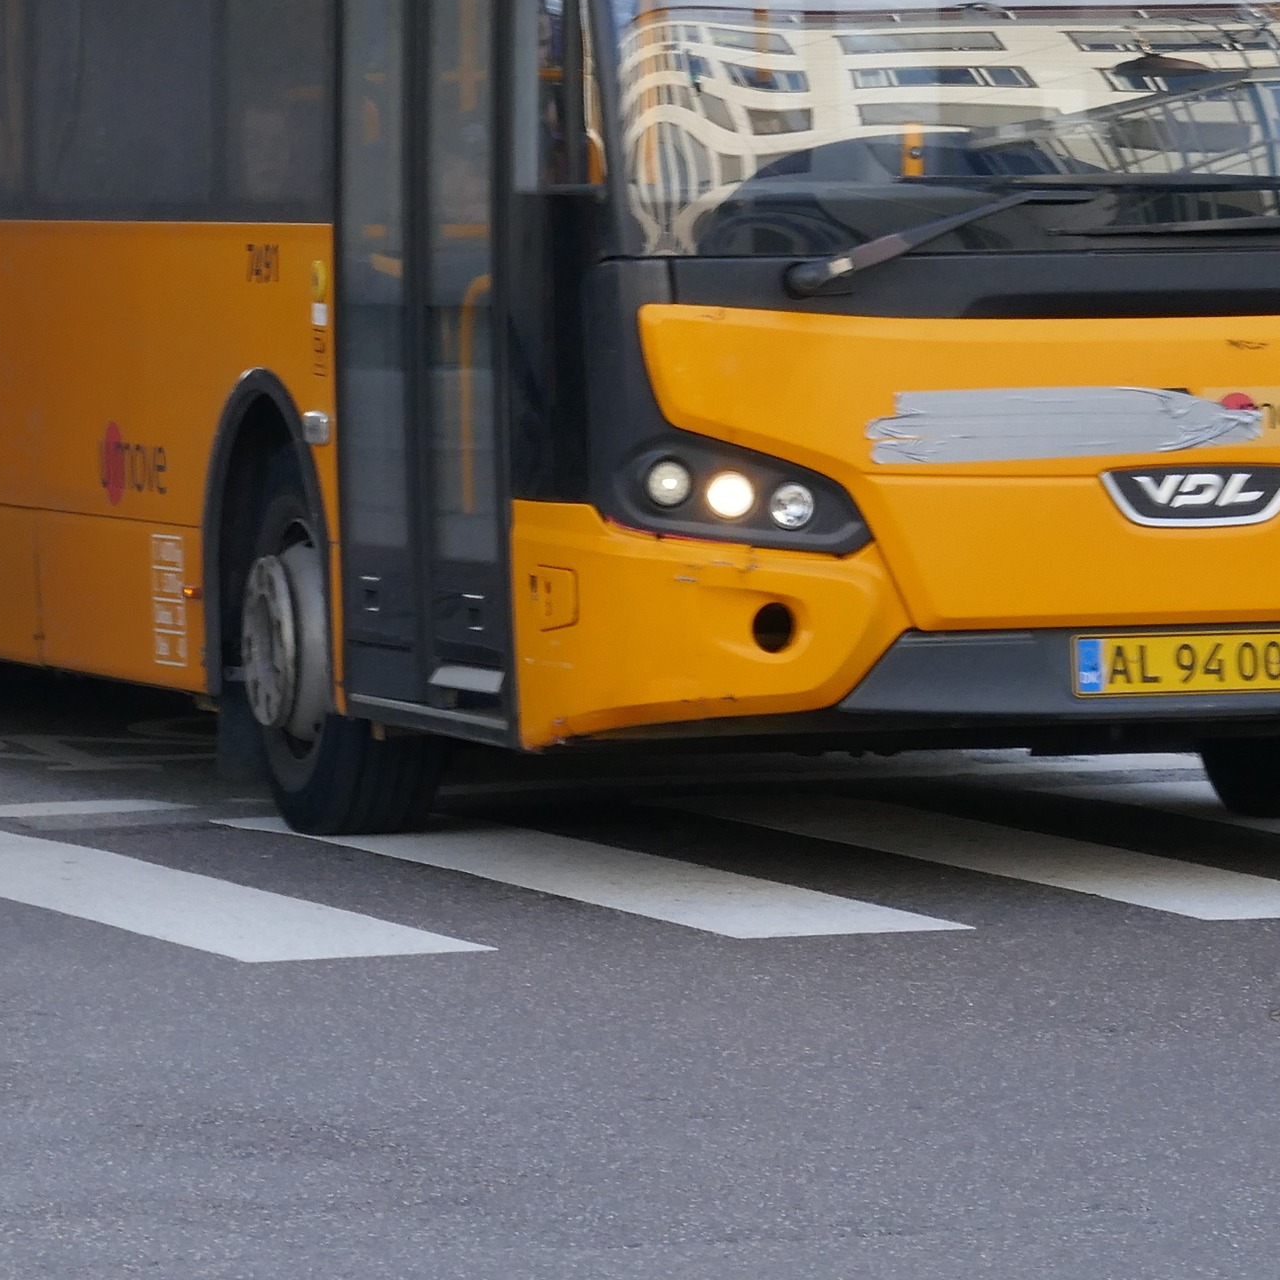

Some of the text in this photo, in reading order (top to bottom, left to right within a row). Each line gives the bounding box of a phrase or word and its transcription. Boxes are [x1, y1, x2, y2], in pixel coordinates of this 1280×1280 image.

[1131, 472, 1265, 509] VDL
[1108, 644, 1161, 684] AL
[1176, 643, 1225, 683] 94
